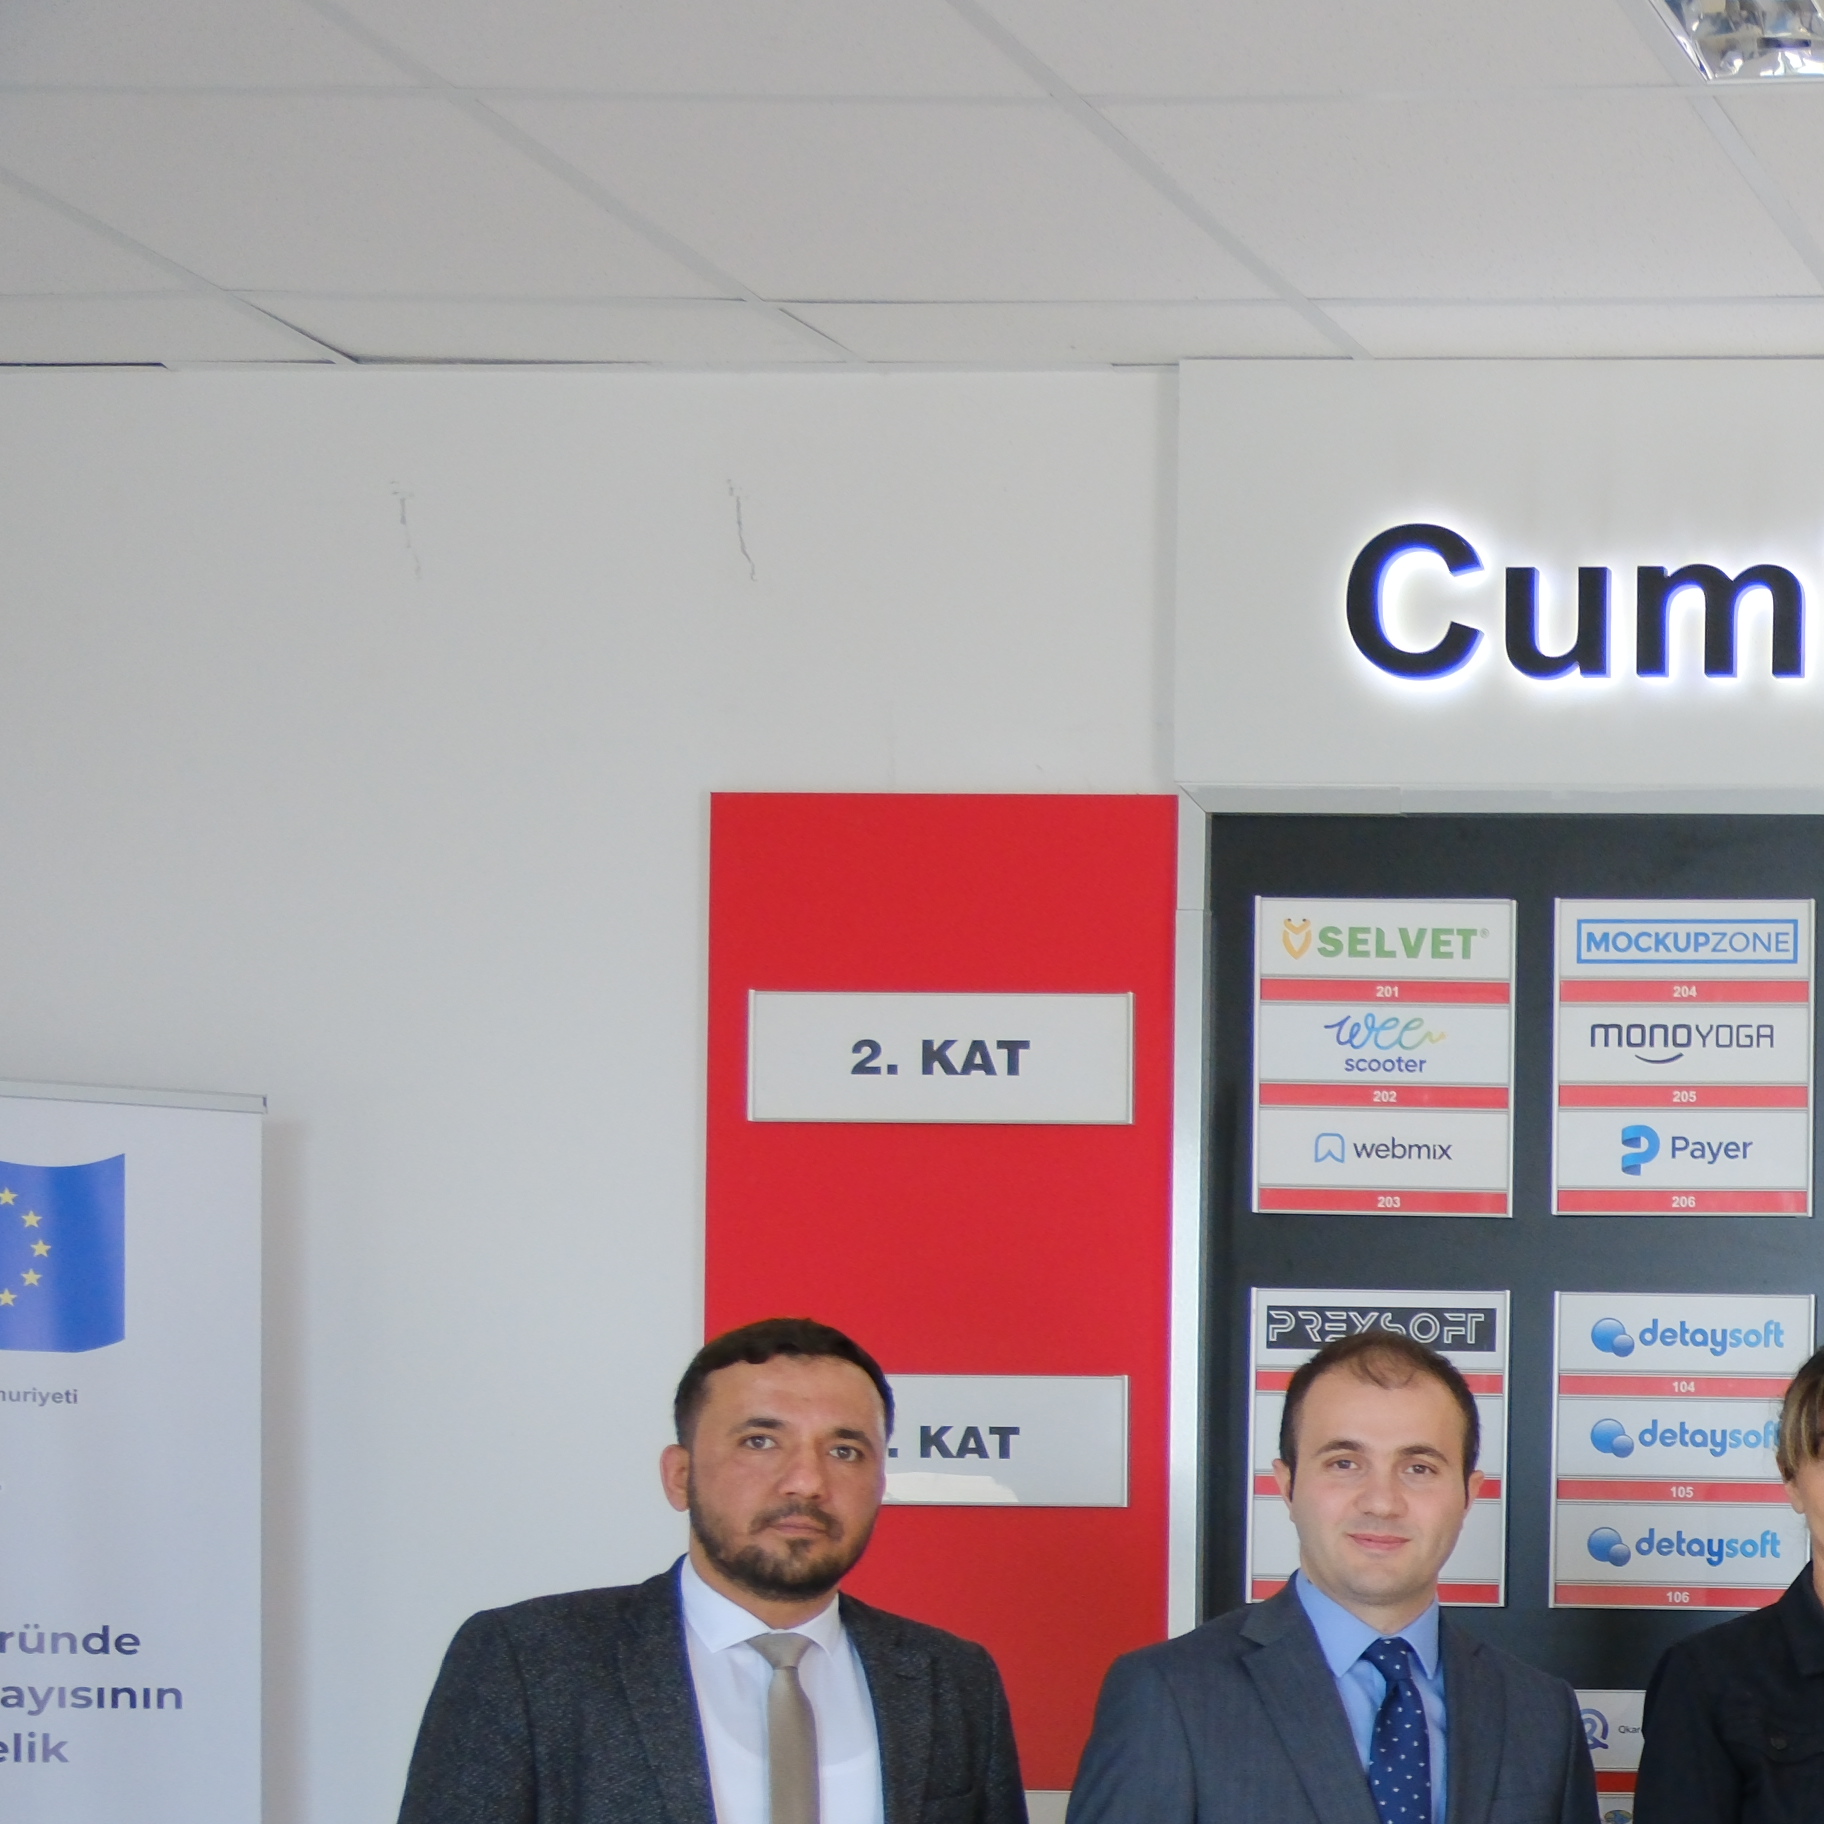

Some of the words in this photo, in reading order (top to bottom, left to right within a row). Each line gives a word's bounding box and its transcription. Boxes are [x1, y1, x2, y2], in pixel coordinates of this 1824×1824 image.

[1585, 930, 1791, 955] MOCKUPZONE
[1376, 986, 1399, 998] 201
[1672, 985, 1698, 998] 204
[850, 1039, 899, 1076] 2.
[920, 1039, 1030, 1076] KAT
[1344, 1056, 1426, 1073] scooter
[1373, 1090, 1397, 1103] 202
[1672, 1090, 1698, 1103] 205
[1353, 1136, 1453, 1161] webmix
[1670, 1135, 1754, 1166] Payer
[1377, 1196, 1401, 1208] 203
[1670, 1195, 1697, 1208] 206
[1639, 1318, 1785, 1356] detaysoft
[1672, 1381, 1696, 1393] 104
[918, 1425, 1019, 1459] KAT
[1638, 1418, 1782, 1456] detaysoft
[1670, 1486, 1694, 1498] 105
[1635, 1527, 1781, 1566] detaysoft
[1666, 1591, 1690, 1604] 106
[0, 1686, 183, 1716] ayısının
